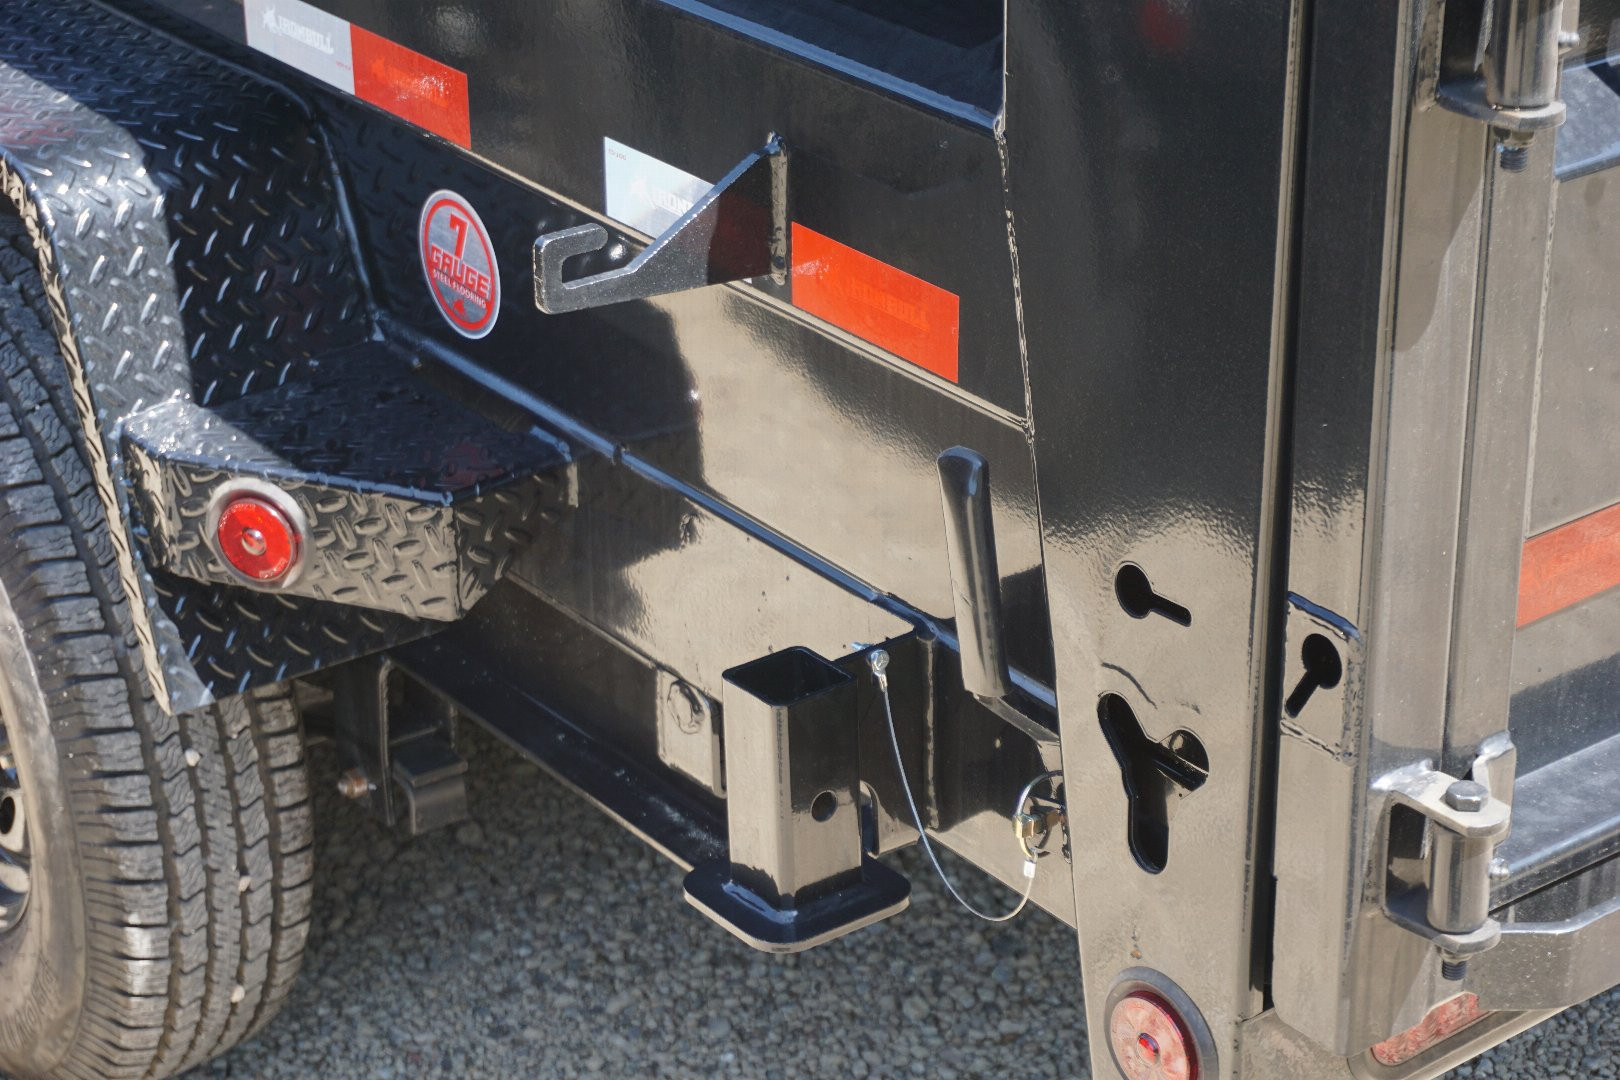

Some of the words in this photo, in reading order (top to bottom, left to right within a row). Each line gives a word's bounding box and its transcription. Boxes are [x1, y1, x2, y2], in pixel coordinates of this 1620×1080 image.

[449, 212, 469, 260] 7
[430, 243, 491, 300] GAUGE
[433, 268, 452, 289] STEEL
[452, 280, 487, 309] FLOORING
